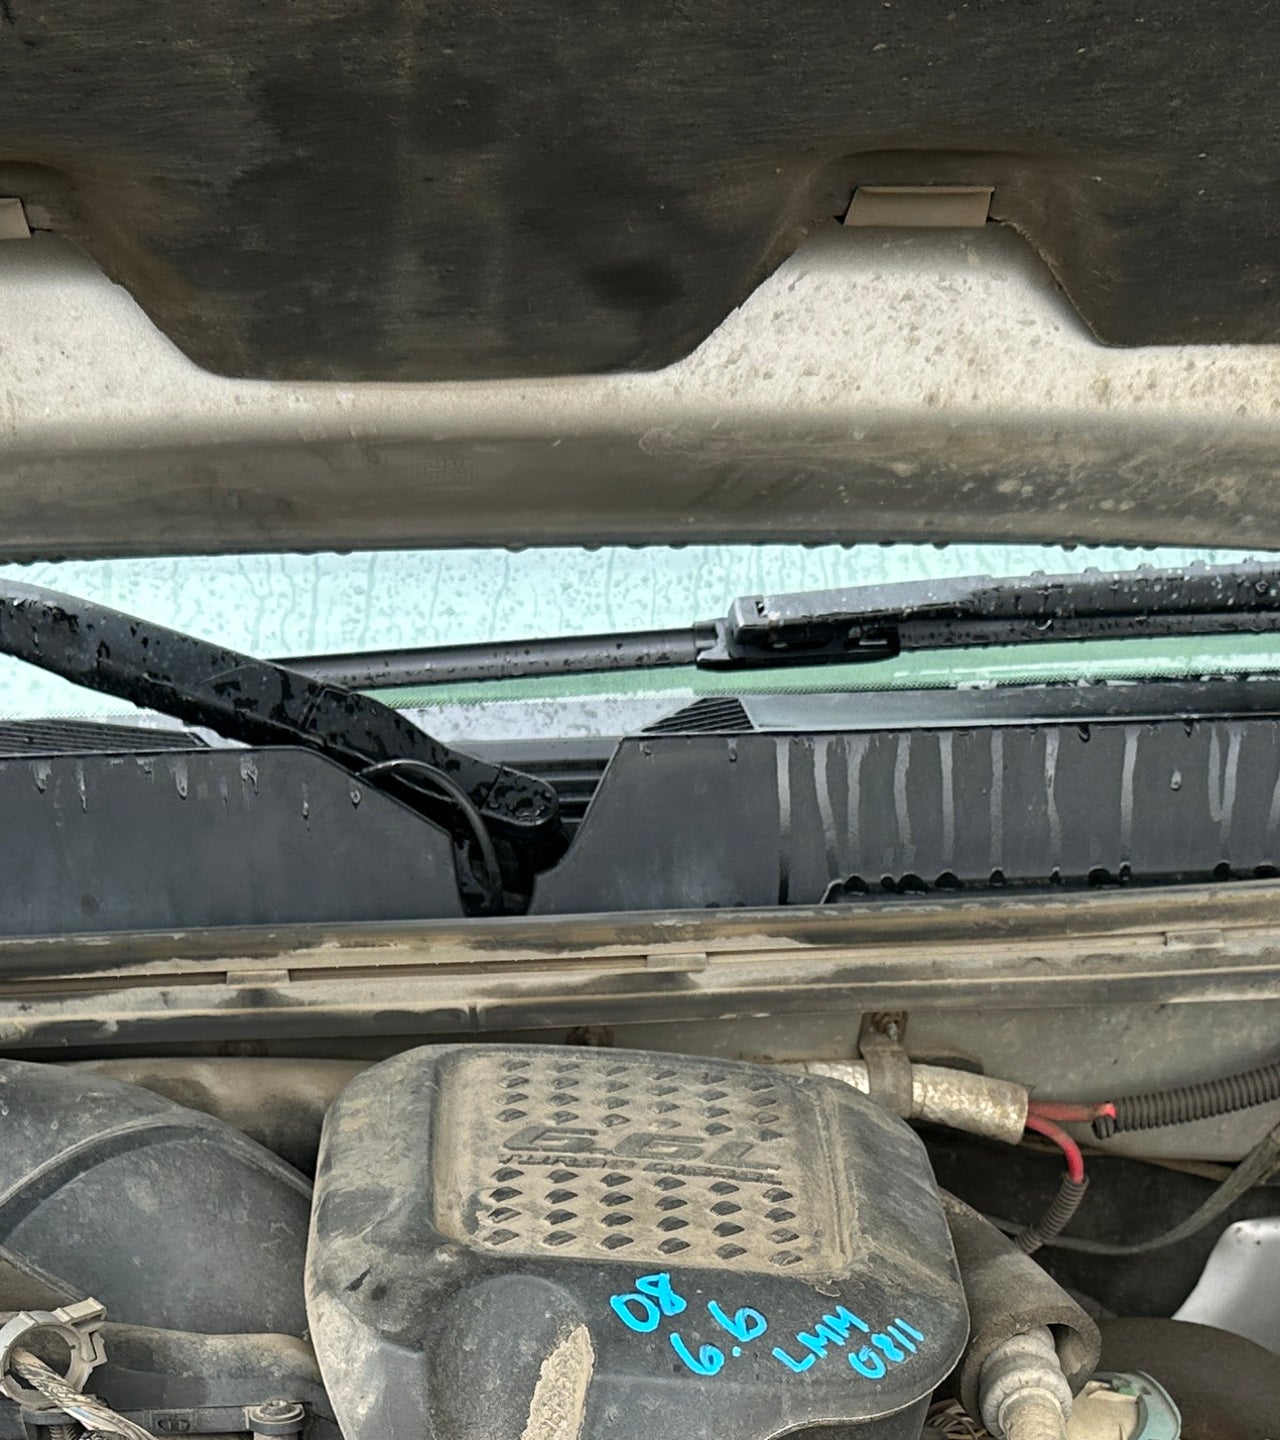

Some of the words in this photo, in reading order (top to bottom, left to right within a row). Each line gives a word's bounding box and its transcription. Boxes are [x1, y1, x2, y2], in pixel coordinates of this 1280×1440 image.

[610, 1272, 687, 1333] 08
[669, 1300, 767, 1376] 6.6
[848, 1318, 924, 1379] 0811
